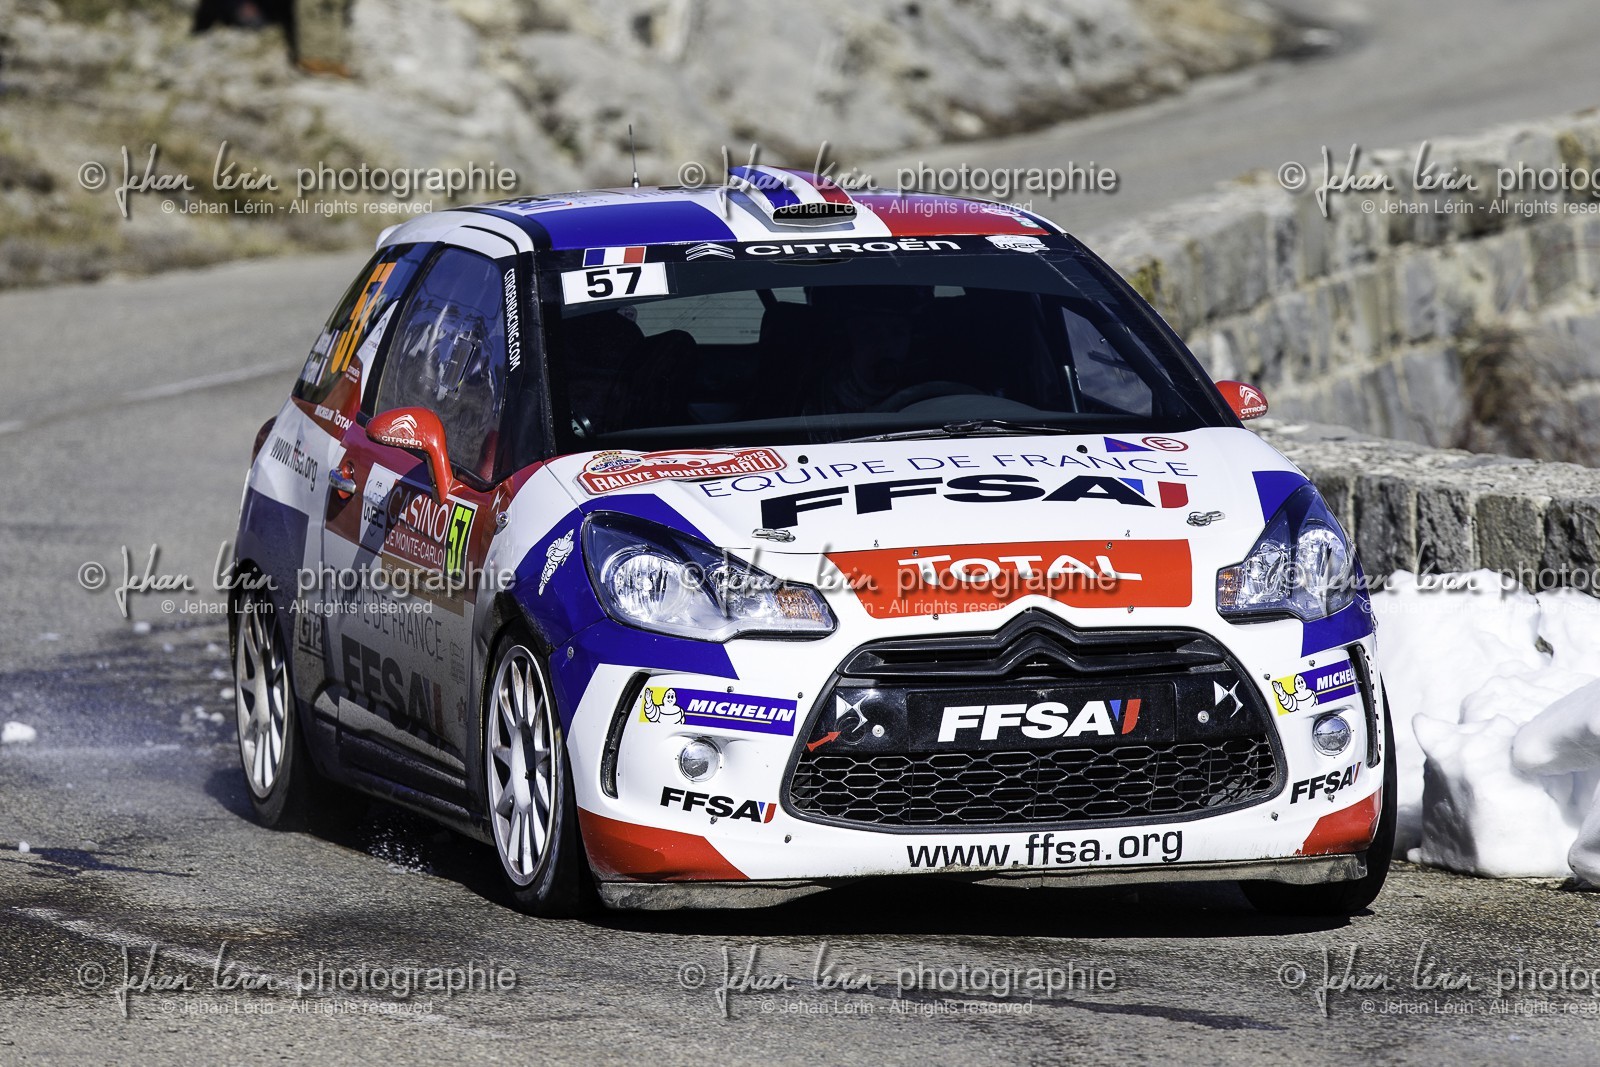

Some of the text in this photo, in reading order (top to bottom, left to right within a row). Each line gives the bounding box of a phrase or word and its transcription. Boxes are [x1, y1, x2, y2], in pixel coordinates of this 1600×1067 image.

[745, 238, 961, 255] CITROËN
[586, 266, 642, 298] 57
[331, 262, 397, 374] 57
[504, 268, 521, 372] CITROENRACING.COM
[381, 435, 422, 447] CITROËN
[270, 437, 318, 492] www.ffsa.org
[591, 472, 655, 492] RALLYE
[656, 456, 777, 478] MONTE-CARLO
[699, 453, 1198, 498] EQUIPE DE FRANCE
[388, 485, 449, 543] CASINO
[760, 474, 1156, 529] FFSA
[395, 532, 444, 566] MONTE-CARLO
[448, 505, 473, 577] 57
[898, 554, 1142, 585] TOTAL
[392, 600, 444, 662] FRANCE
[687, 699, 795, 722] MICHELIN
[937, 700, 1116, 742] FFSA
[1290, 765, 1354, 804] FFSA
[660, 786, 763, 823] FFSA
[906, 830, 1183, 867] www.ffsa.org
